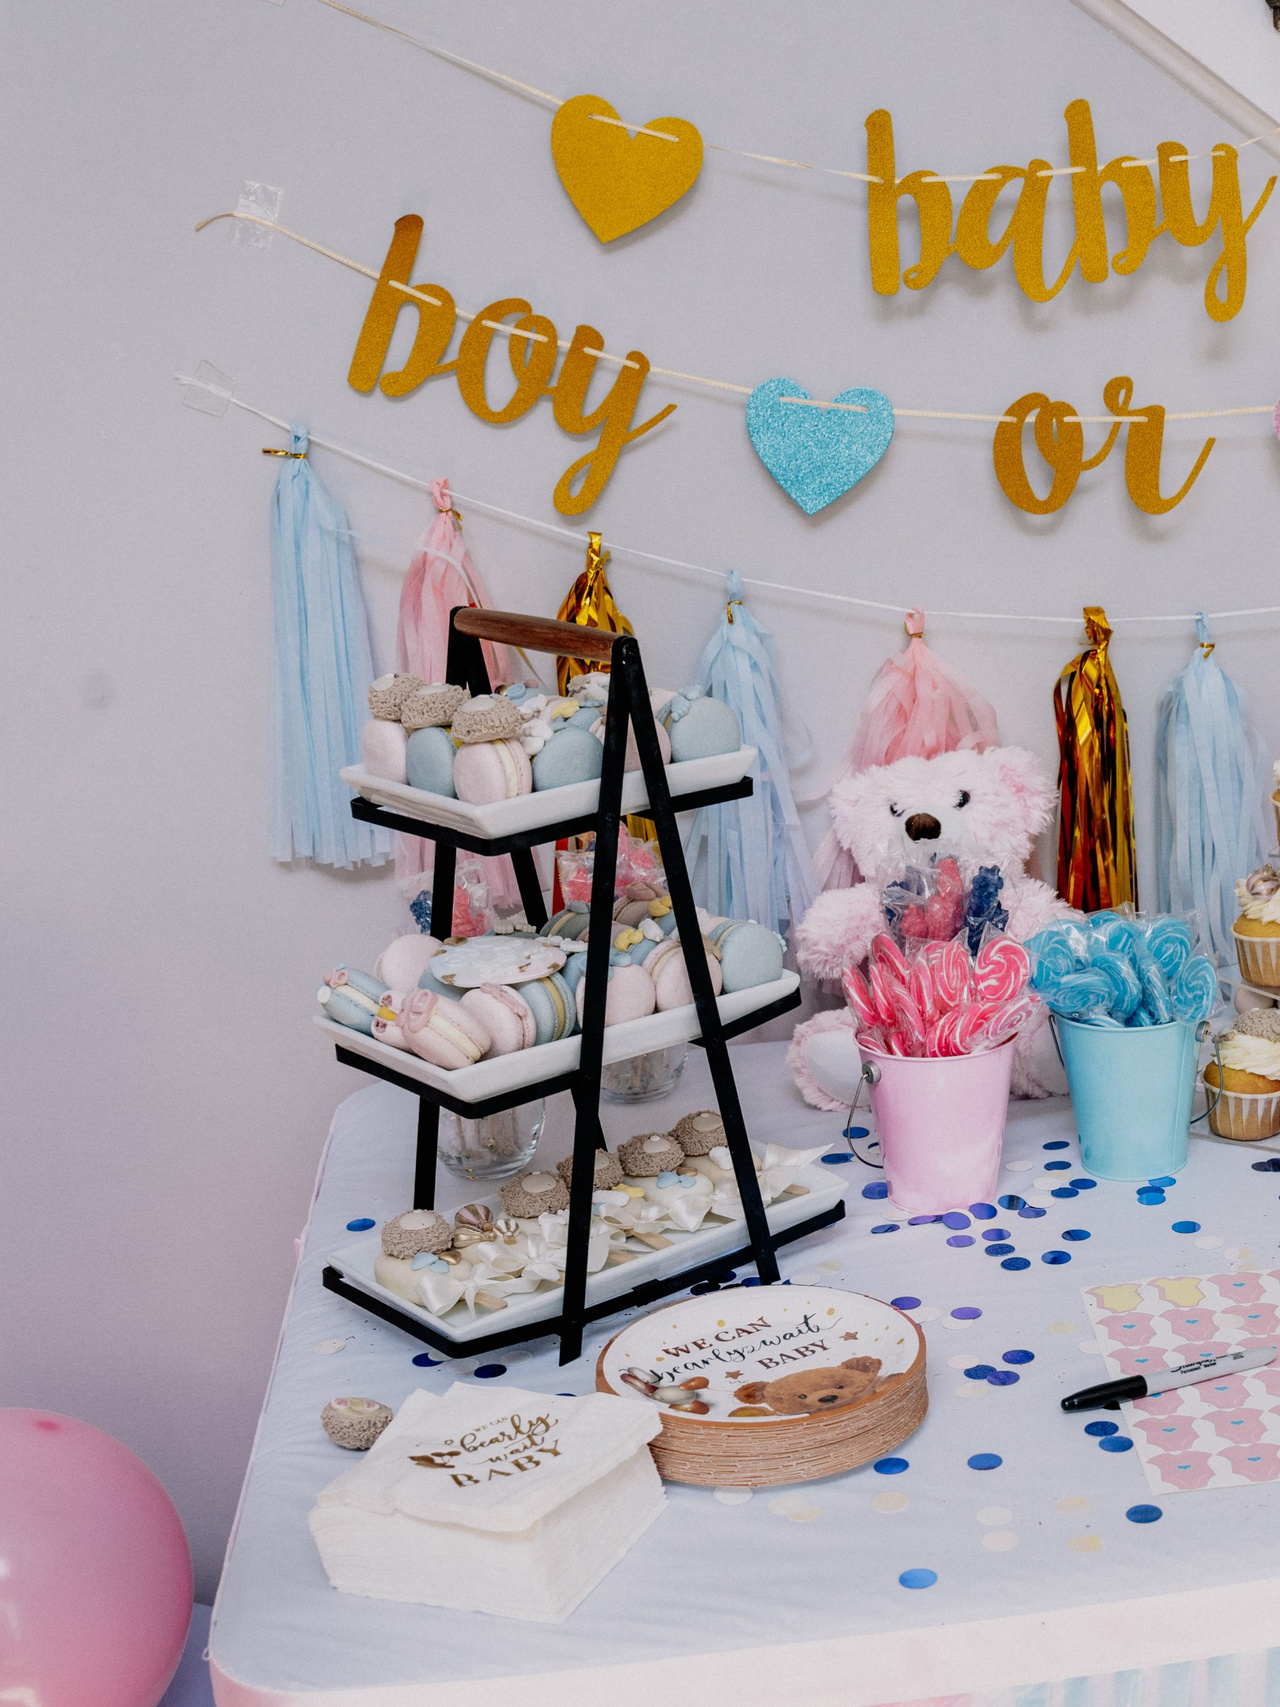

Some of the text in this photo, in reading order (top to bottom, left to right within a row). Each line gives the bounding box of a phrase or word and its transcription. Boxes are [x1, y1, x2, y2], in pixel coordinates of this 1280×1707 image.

[865, 98, 1277, 322] baby
[348, 214, 677, 516] boy
[993, 376, 1216, 515] or
[661, 1316, 772, 1358] WE CAN
[753, 1313, 838, 1350] wait
[755, 1339, 832, 1370] BABY
[460, 1413, 559, 1453] bearly
[474, 1415, 508, 1433] WE CAN
[450, 1439, 563, 1488] BABY
[478, 1434, 545, 1464] wait
